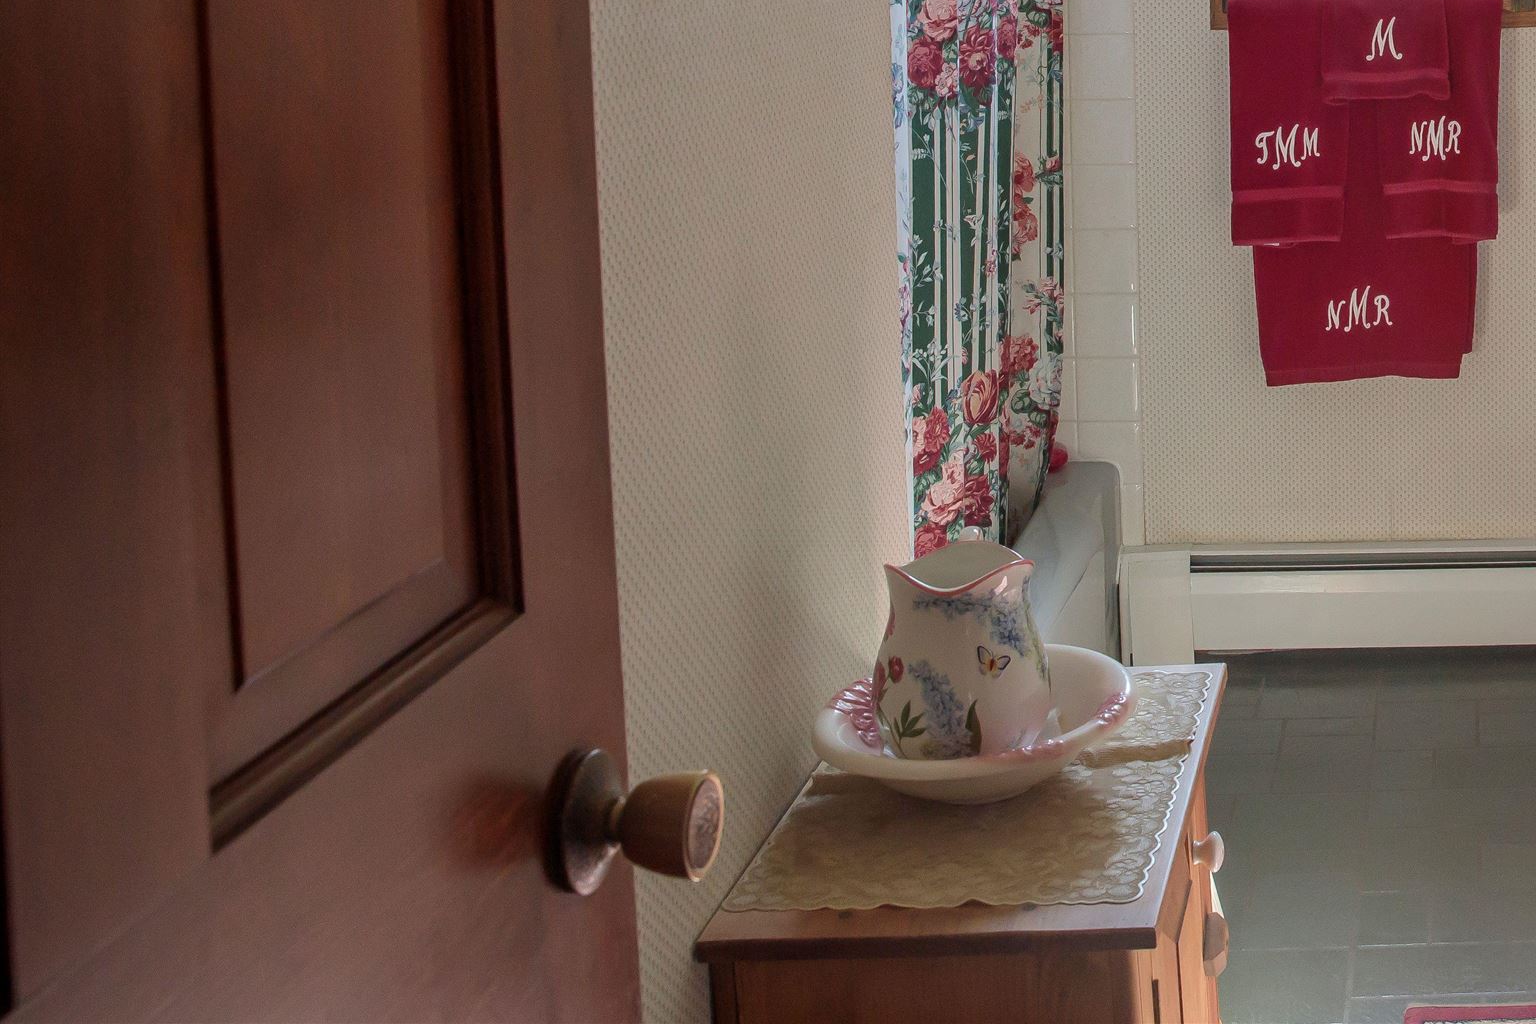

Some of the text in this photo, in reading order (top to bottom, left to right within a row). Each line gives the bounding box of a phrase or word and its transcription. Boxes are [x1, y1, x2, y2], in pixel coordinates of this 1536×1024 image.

[1366, 16, 1403, 62] M
[1408, 115, 1462, 162] NMR
[1325, 285, 1393, 333] NMR
